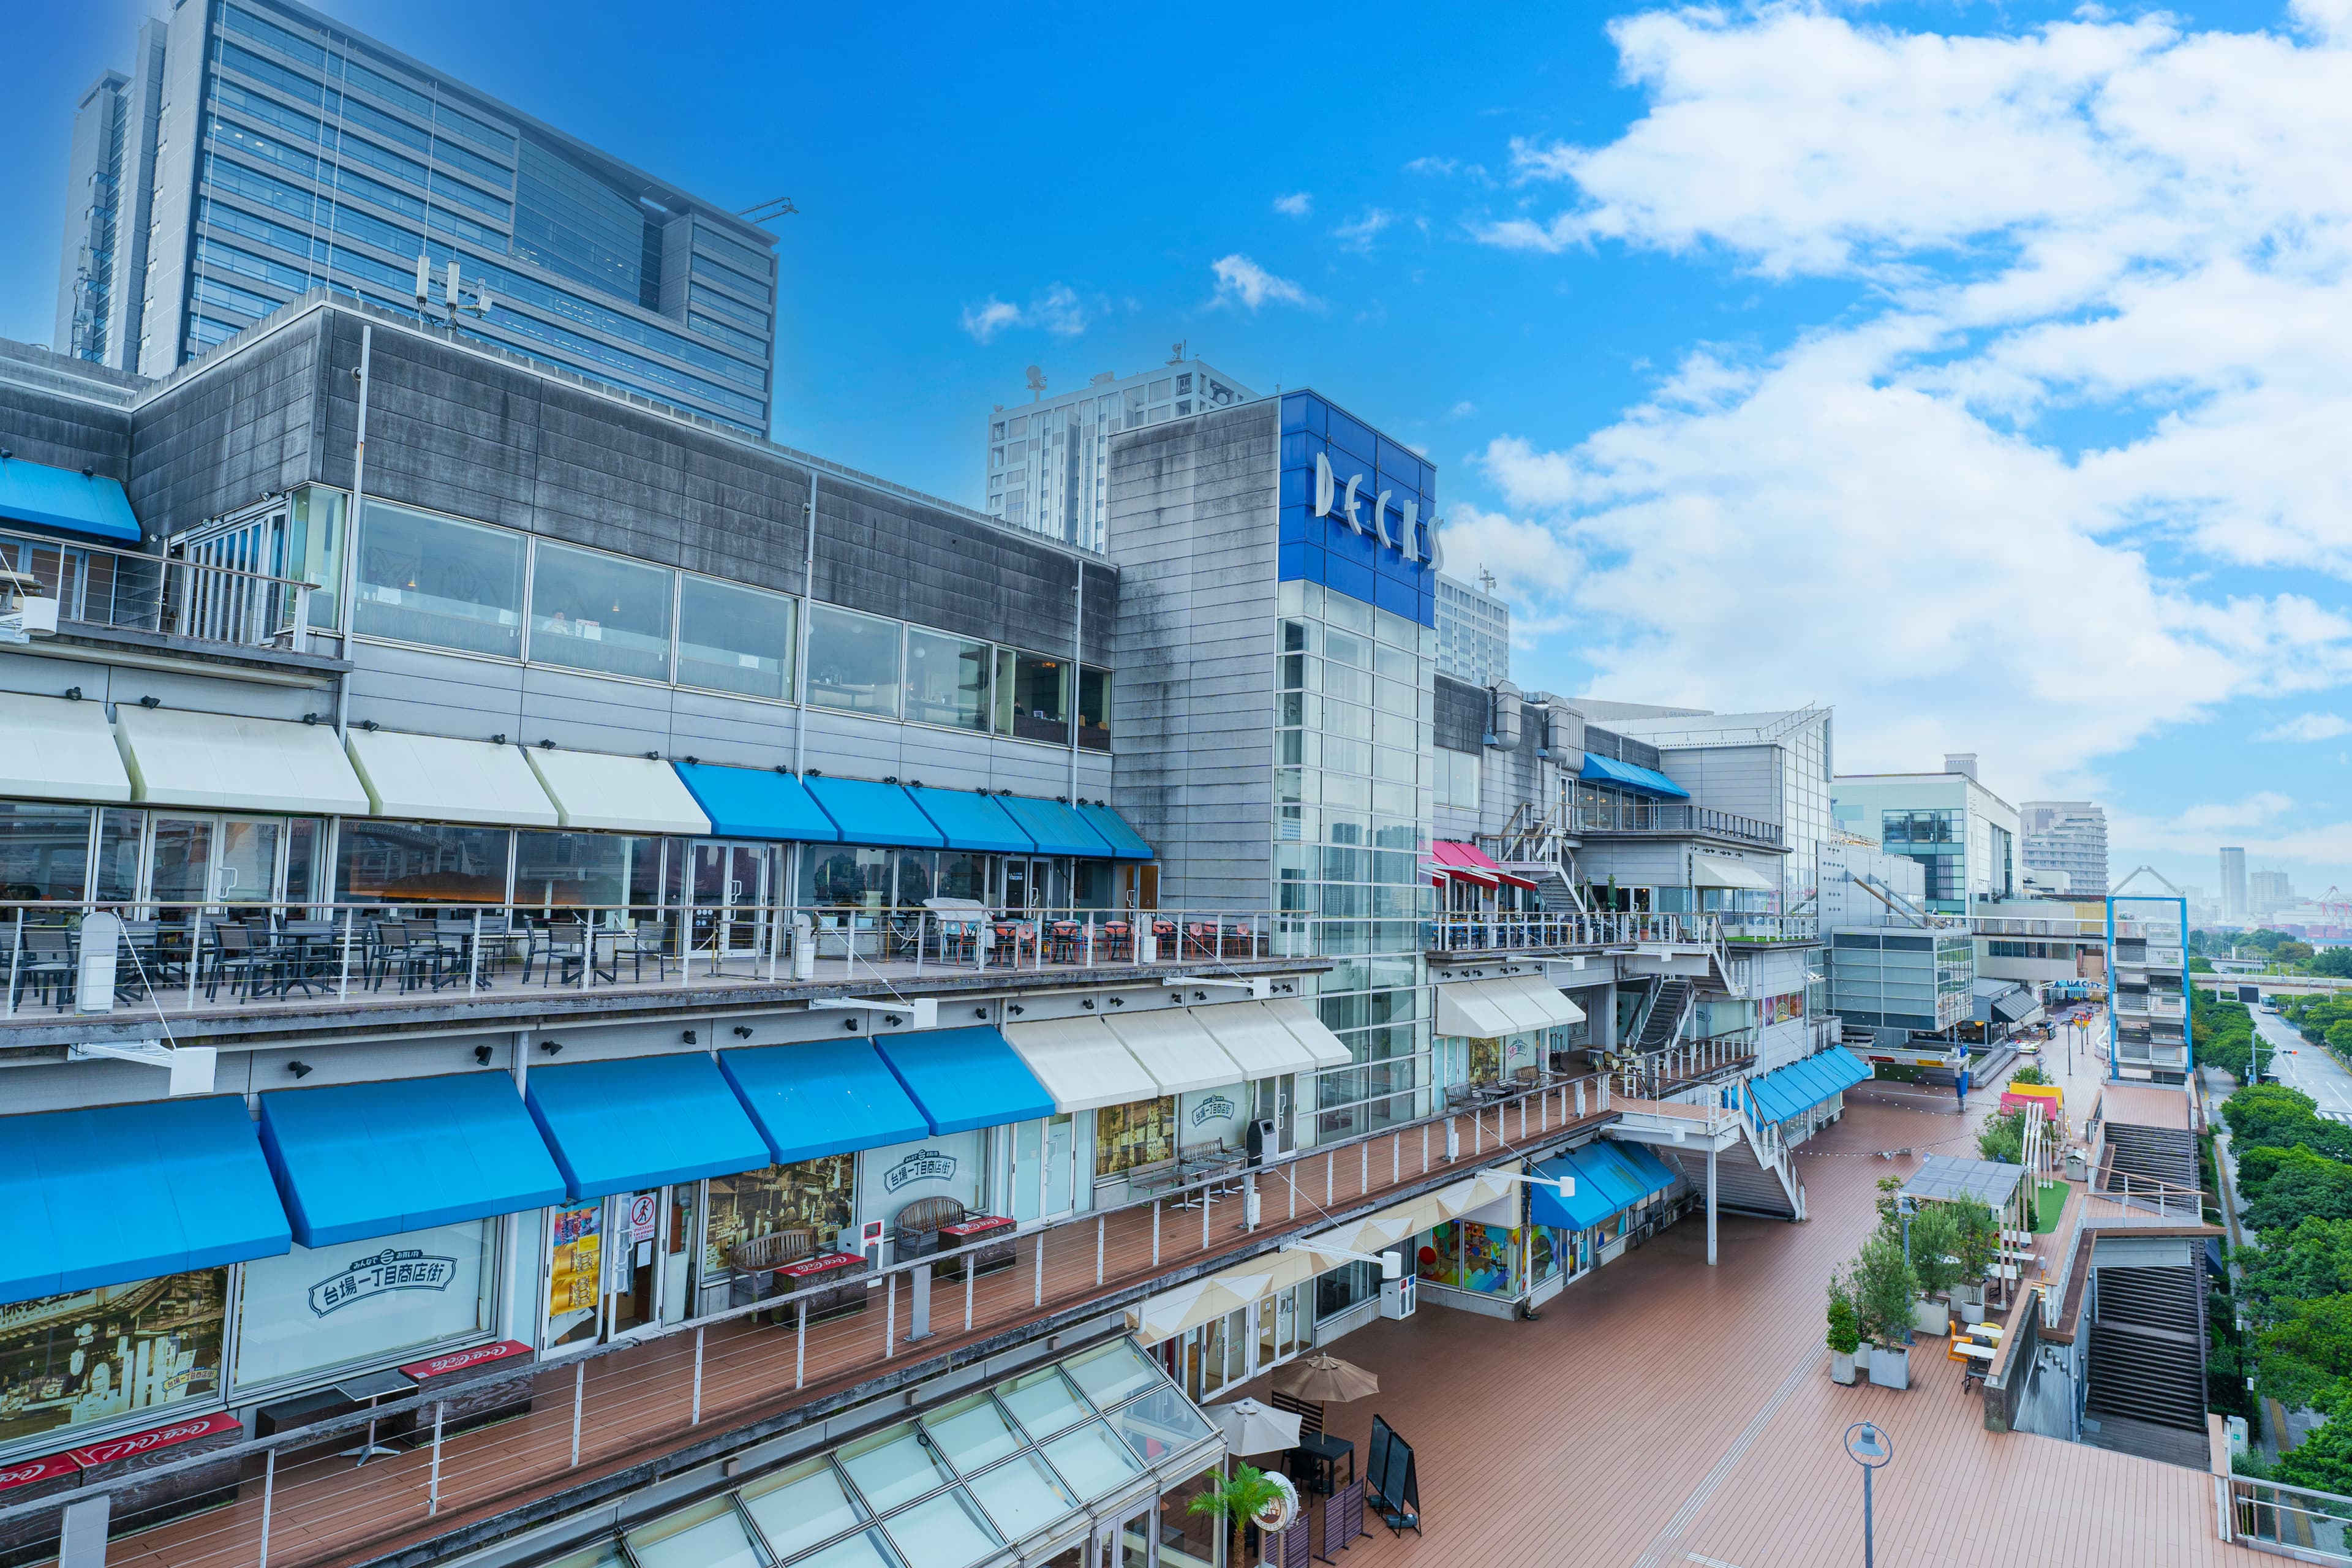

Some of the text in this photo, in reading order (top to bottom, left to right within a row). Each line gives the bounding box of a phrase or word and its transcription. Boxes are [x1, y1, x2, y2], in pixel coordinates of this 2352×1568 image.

[1315, 451, 1444, 571] DECKS
[2052, 980, 2081, 989] AQUA
[891, 1160, 951, 1186] 台場一丁目商店街
[957, 1219, 999, 1232] Coca-Cola
[353, 1256, 378, 1270] みんなで
[796, 1256, 847, 1273] Coca-Cola
[323, 1262, 445, 1306] 台場一丁目商店街
[430, 1346, 507, 1372] Coca-Cola
[1256, 1519, 1280, 1530] COFFEE
